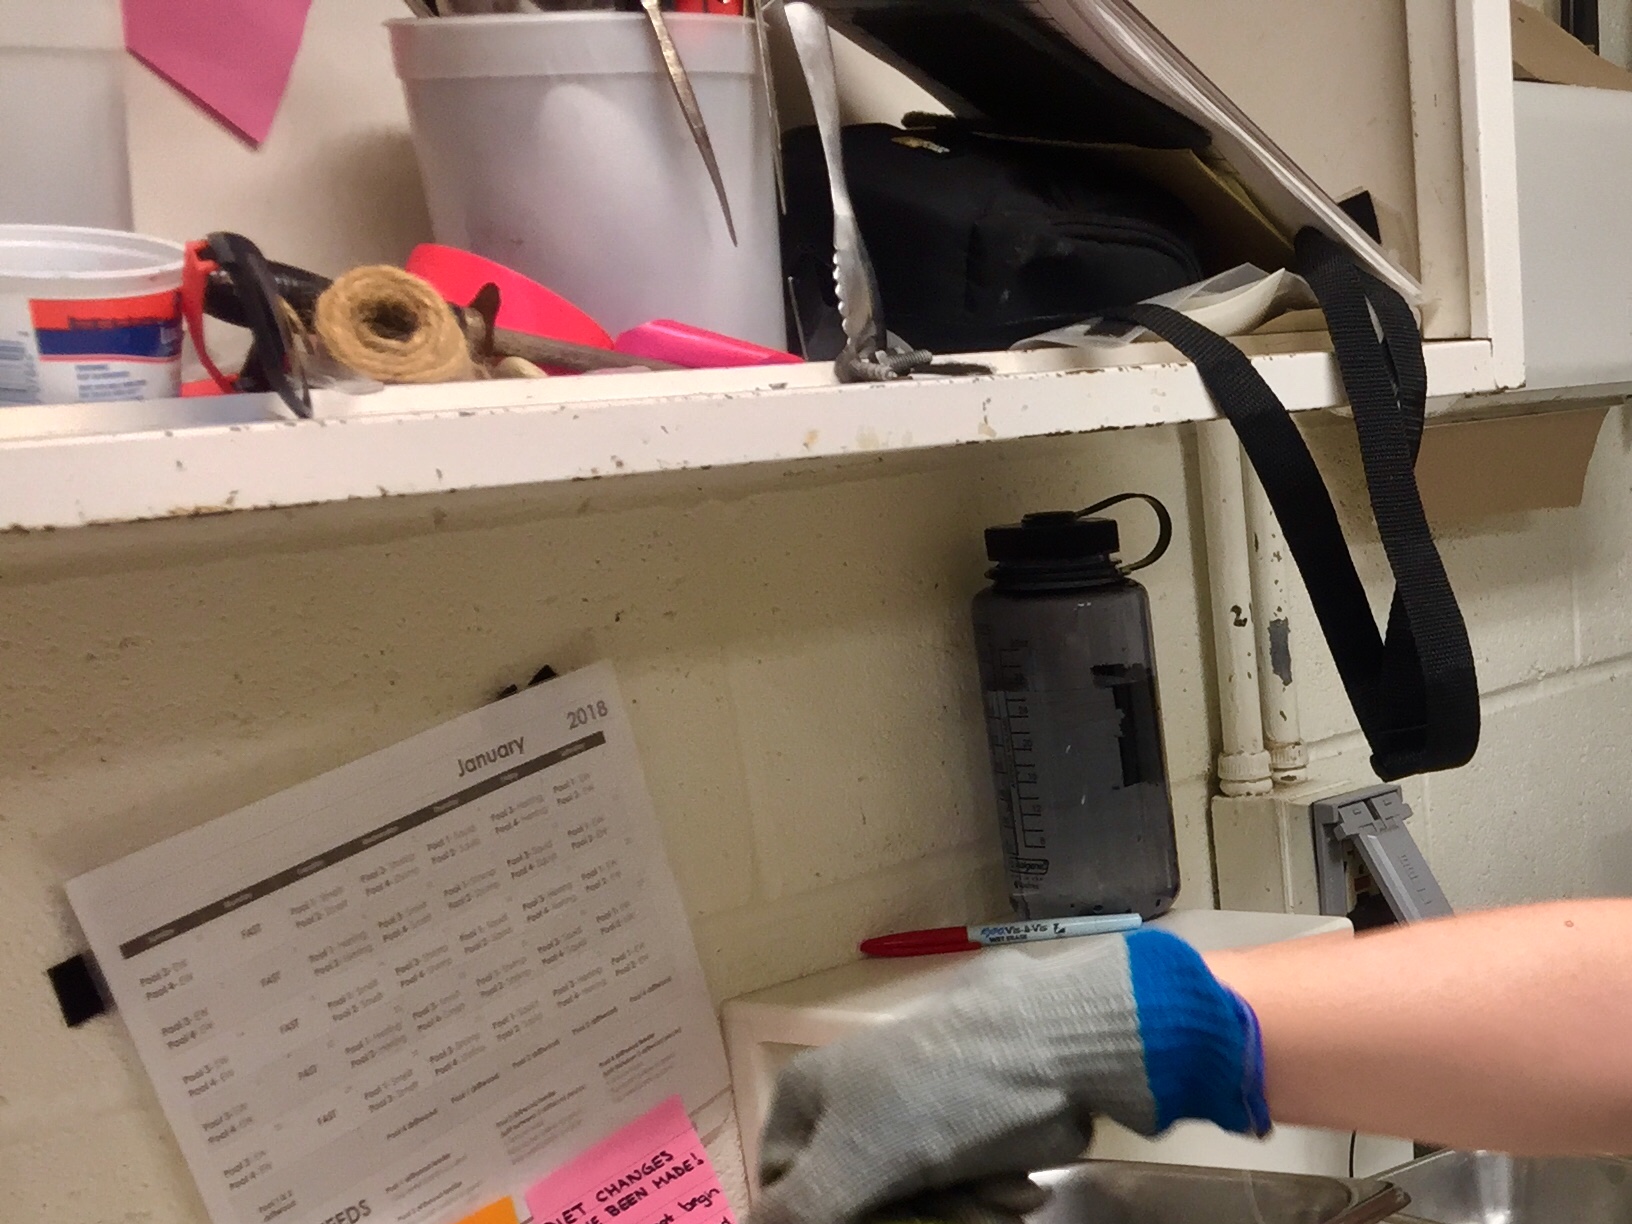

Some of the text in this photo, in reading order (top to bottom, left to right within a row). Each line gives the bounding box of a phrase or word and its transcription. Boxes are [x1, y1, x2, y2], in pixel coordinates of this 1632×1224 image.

[566, 700, 609, 730] 2018
[456, 734, 526, 778] January
[595, 1150, 675, 1204] CHANGES
[604, 1188, 648, 1218] BEEN
[652, 1152, 705, 1190] MADE!
[678, 1186, 721, 1213] begin
